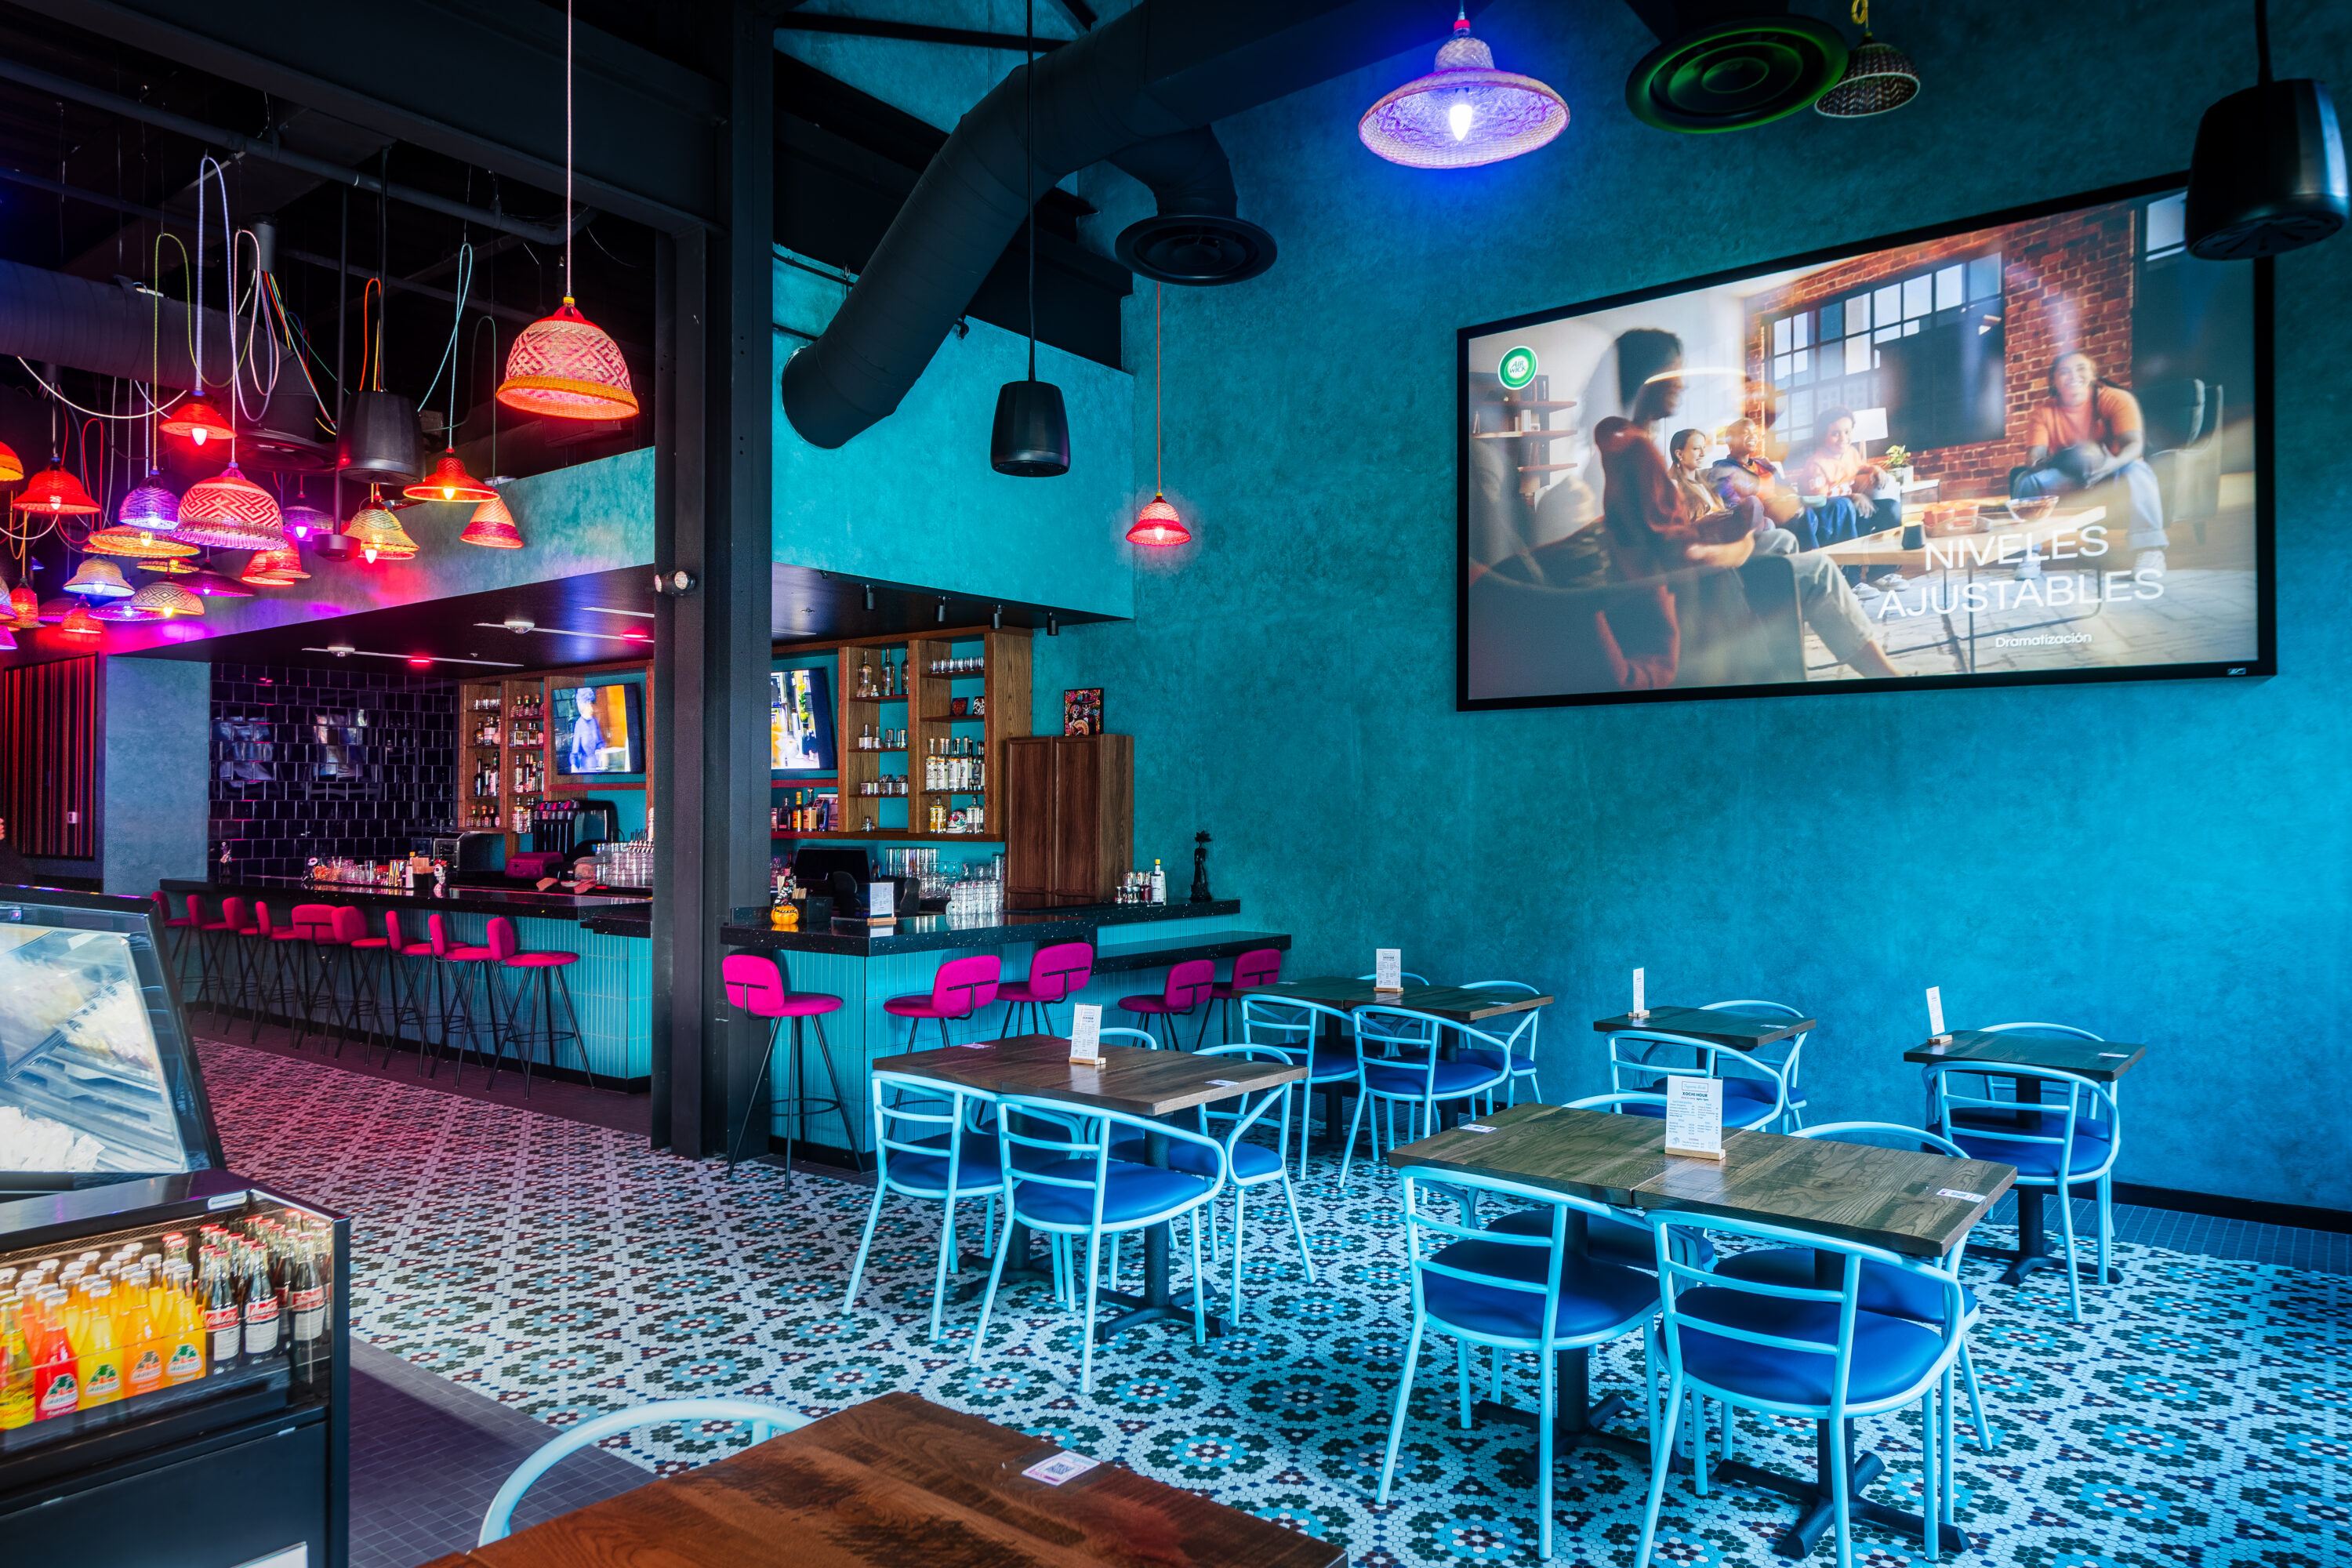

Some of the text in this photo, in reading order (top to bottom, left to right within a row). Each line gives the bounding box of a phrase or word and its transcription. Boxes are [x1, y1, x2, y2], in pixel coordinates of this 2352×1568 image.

[1925, 525, 2109, 572] NIVELES
[1877, 568, 2165, 619] AJUSTABLES
[1995, 632, 2092, 648] Dramatización
